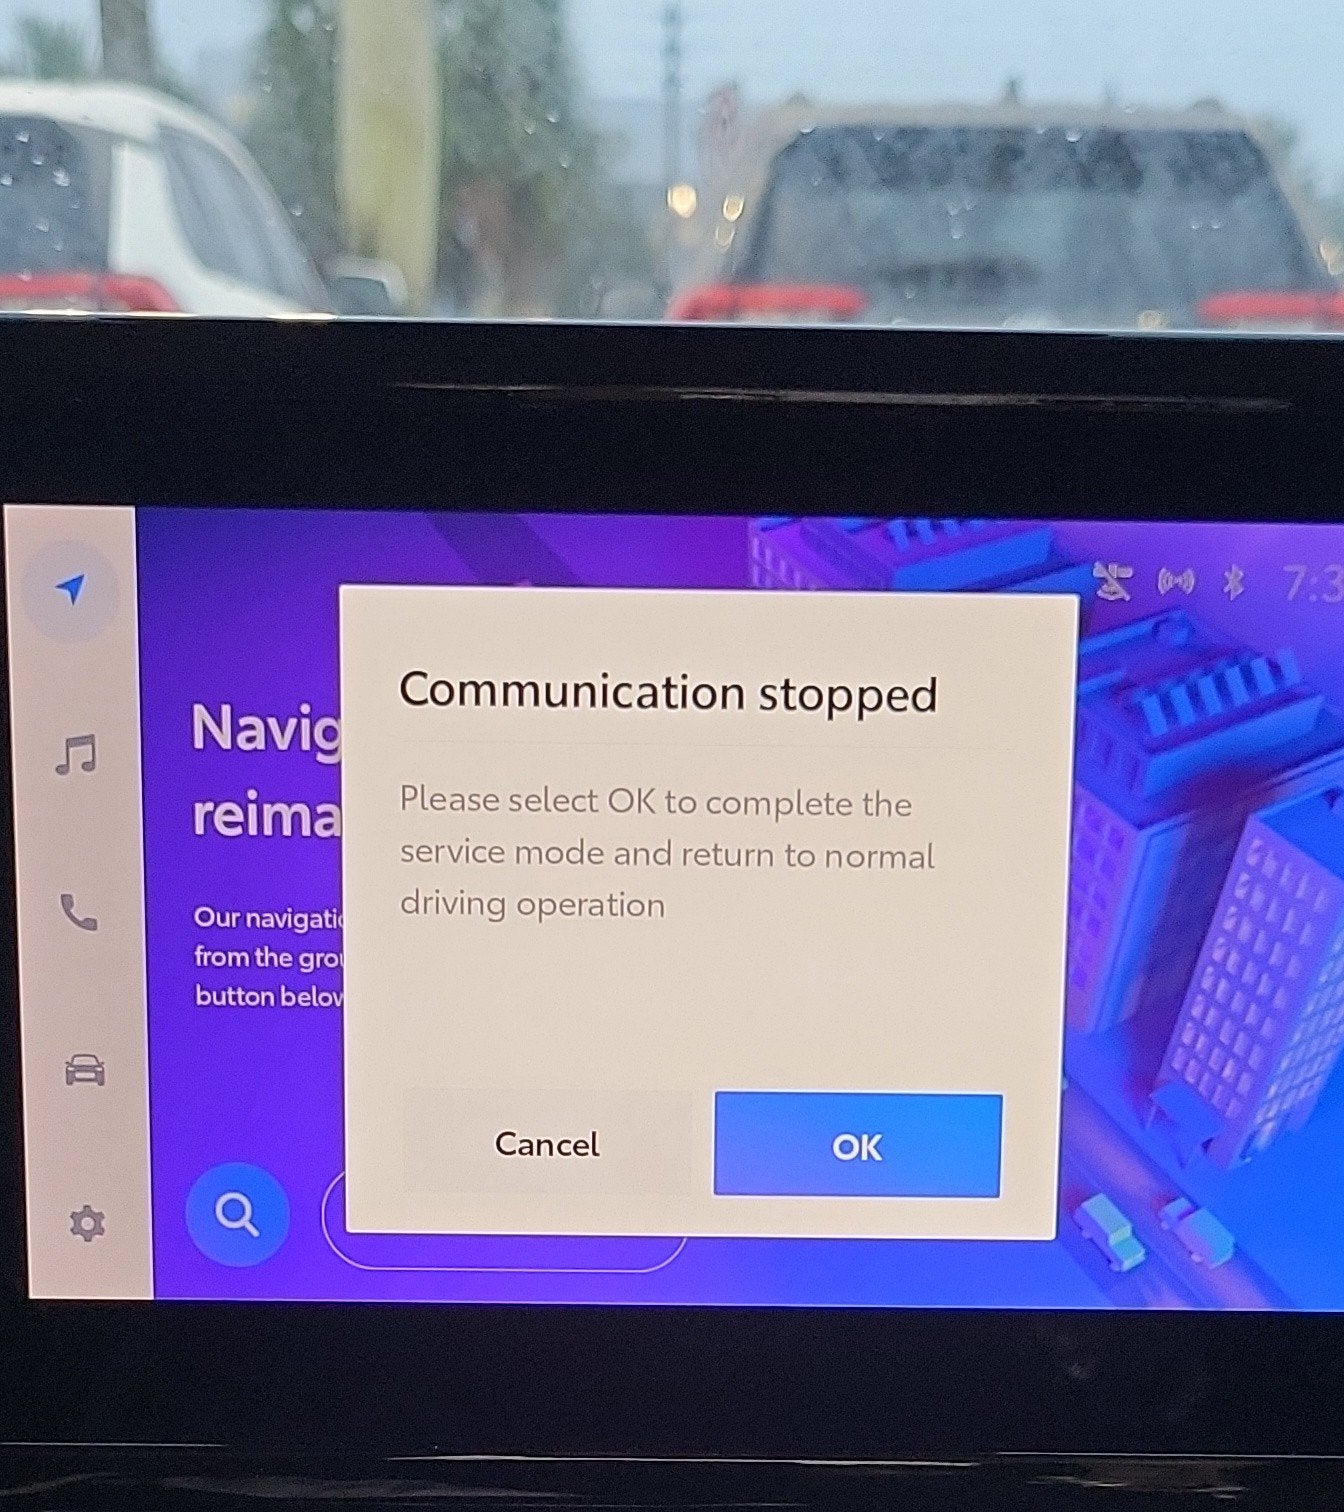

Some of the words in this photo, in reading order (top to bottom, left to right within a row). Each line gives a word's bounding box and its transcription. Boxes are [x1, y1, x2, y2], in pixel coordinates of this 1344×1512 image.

[399, 670, 745, 711] Communication
[758, 675, 938, 722] stopped
[193, 703, 341, 764] Navig
[194, 789, 342, 838] reima
[400, 783, 500, 813] Please
[508, 784, 599, 814] select
[607, 787, 657, 815] OK
[664, 790, 698, 816] to
[706, 787, 853, 824] complete
[862, 788, 913, 818] the
[400, 836, 506, 865] service
[514, 836, 605, 866] mode
[613, 838, 673, 867] and
[681, 843, 775, 868] return
[784, 842, 817, 869] to
[824, 841, 936, 870] normal
[194, 906, 241, 928] Our
[400, 887, 507, 924] driving
[516, 890, 666, 925] operation
[194, 944, 249, 967] from
[255, 945, 293, 968] the
[299, 952, 343, 973] gro
[196, 984, 275, 1007] button
[494, 1130, 601, 1158] Cancel
[832, 1133, 883, 1162] OK
